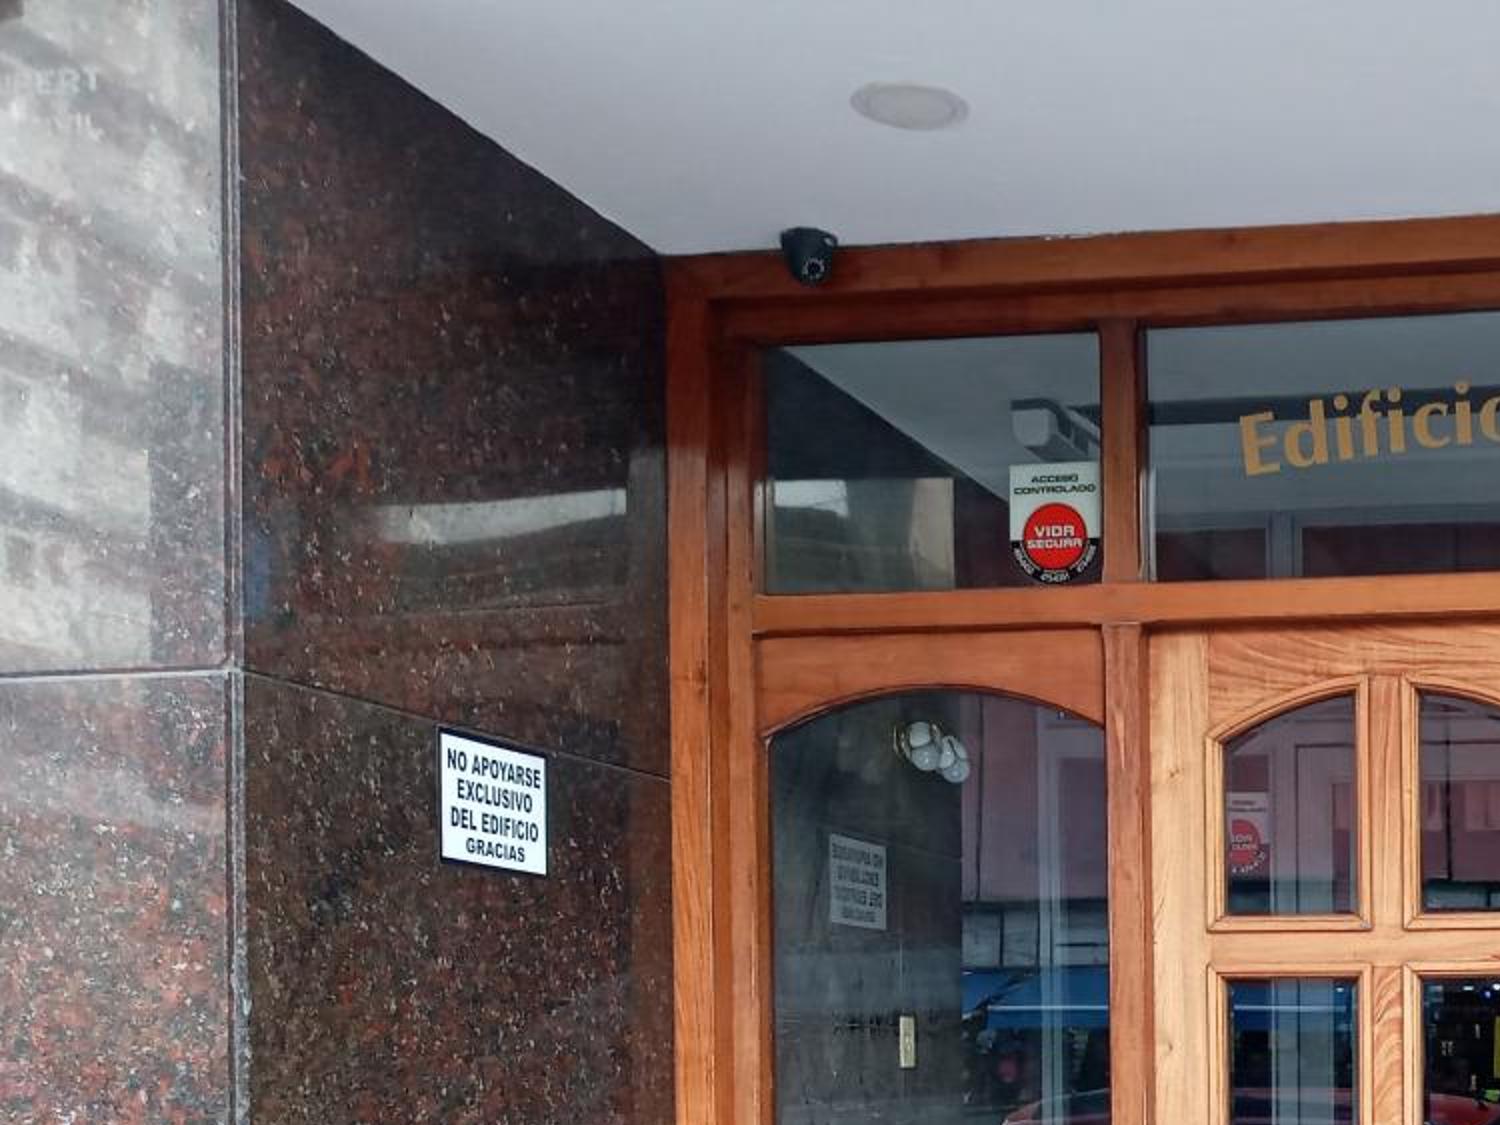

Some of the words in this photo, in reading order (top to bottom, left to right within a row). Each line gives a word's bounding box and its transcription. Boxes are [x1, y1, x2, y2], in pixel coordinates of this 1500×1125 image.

[1031, 473, 1079, 484] ACCESO
[1013, 484, 1097, 495] CONTROLADO
[1034, 525, 1076, 538] VIDA
[1026, 537, 1084, 550] SEGURA
[447, 748, 468, 772] NO
[472, 754, 541, 790] APOYARSE
[457, 778, 533, 814] EXCLUSIVO
[450, 805, 477, 831] DEL
[481, 812, 539, 843] EDIFICIO
[465, 837, 526, 863] GRACIAS
